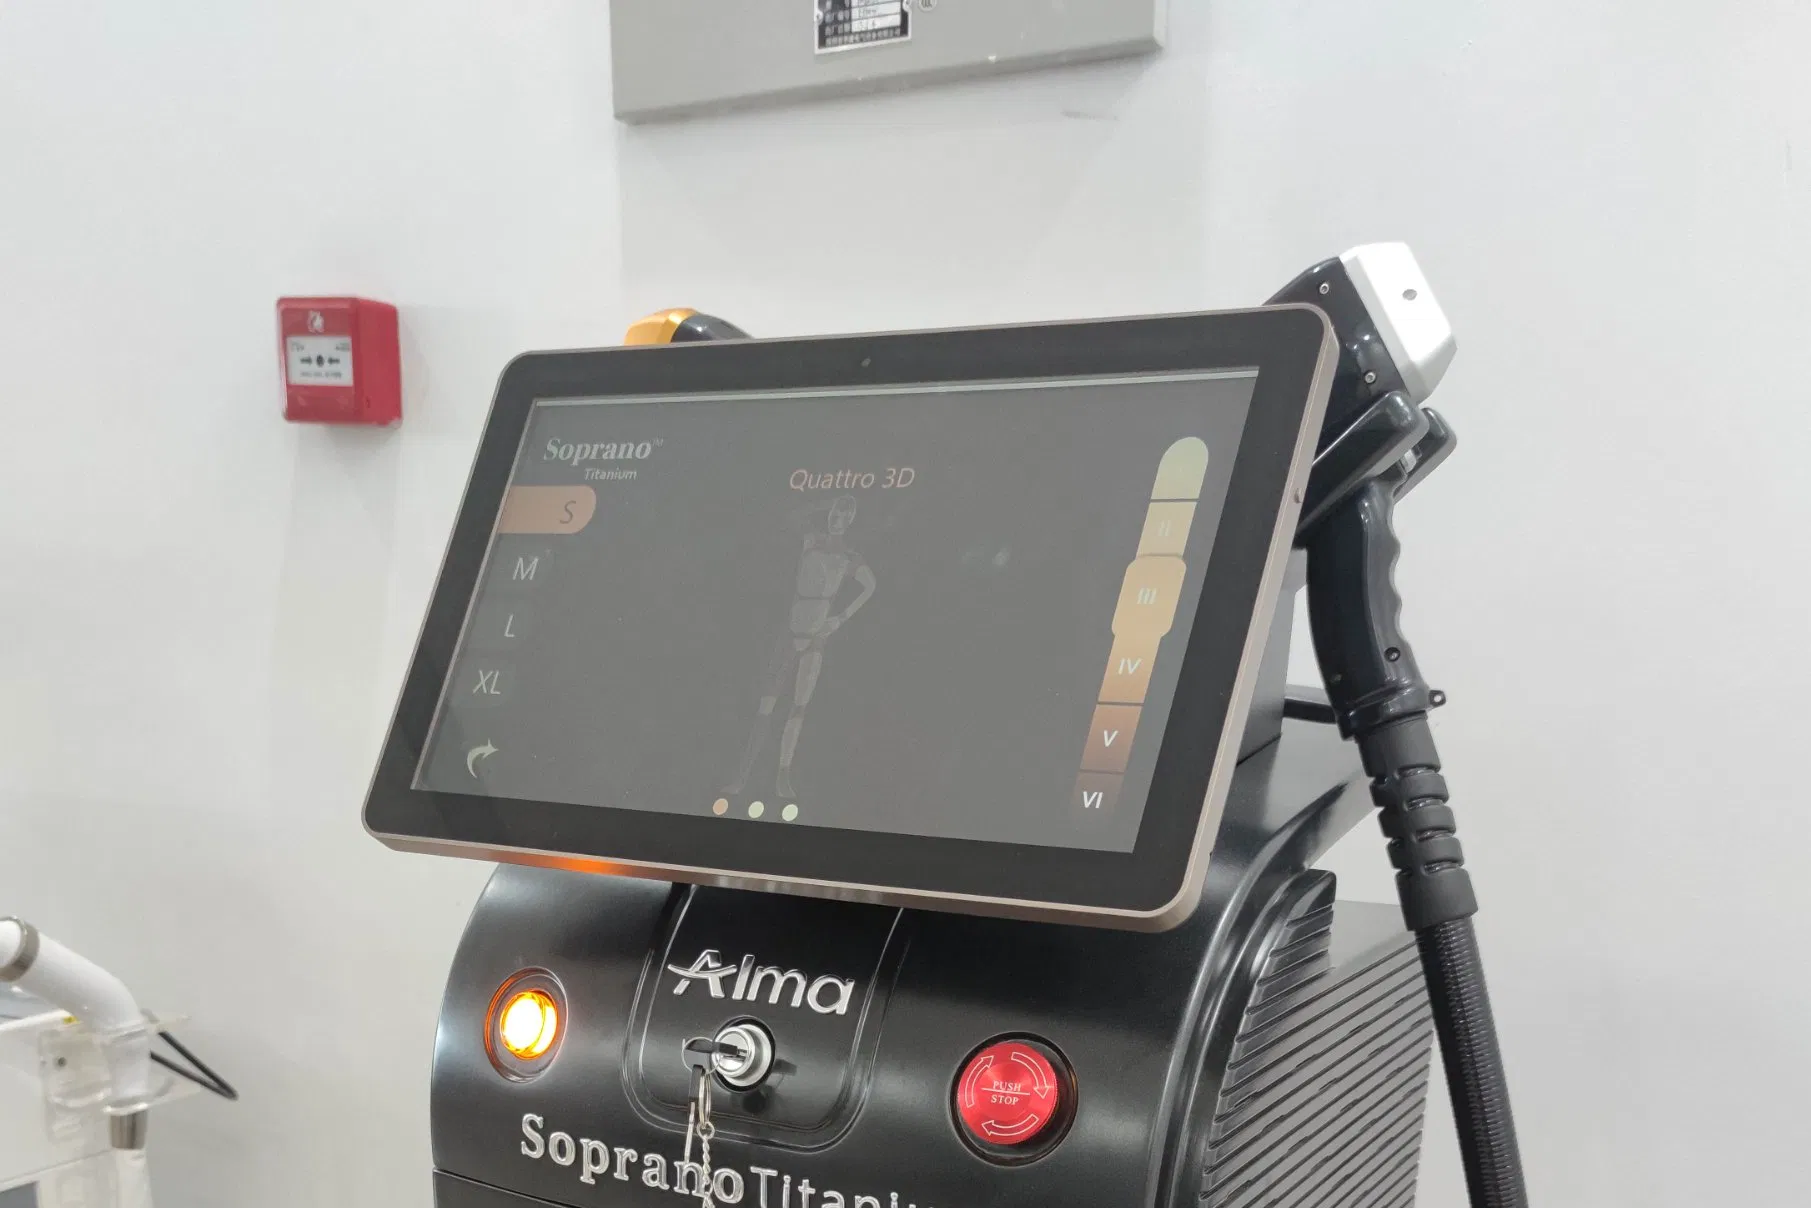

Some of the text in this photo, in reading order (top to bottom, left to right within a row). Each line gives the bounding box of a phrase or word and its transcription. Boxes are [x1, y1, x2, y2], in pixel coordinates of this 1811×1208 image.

[543, 437, 652, 466] Soprano
[584, 466, 638, 481] Titanium
[789, 467, 916, 491] Quattro 3D
[558, 500, 577, 524] S
[512, 556, 540, 582] M
[1136, 587, 1157, 605] III
[503, 615, 516, 638] L
[1118, 657, 1142, 675] IV
[472, 669, 502, 696] XL
[1103, 730, 1118, 747] V
[1082, 791, 1103, 809] VI
[667, 949, 855, 1015] Alma
[992, 1080, 1023, 1092] PUSH
[990, 1094, 1019, 1105] STOP
[520, 1113, 745, 1204] Soprano
